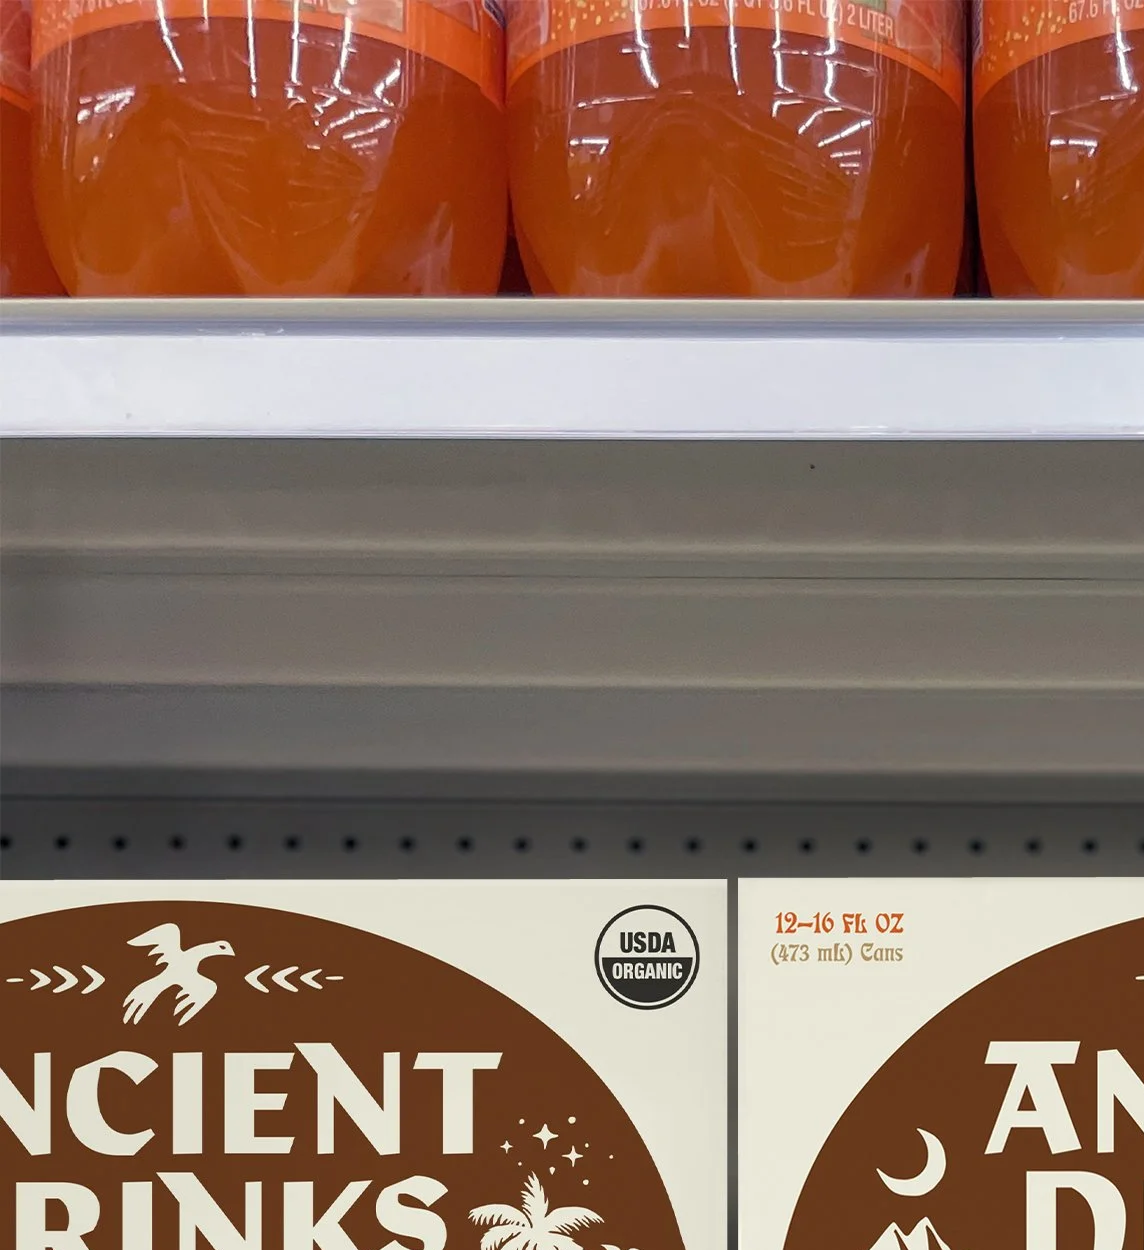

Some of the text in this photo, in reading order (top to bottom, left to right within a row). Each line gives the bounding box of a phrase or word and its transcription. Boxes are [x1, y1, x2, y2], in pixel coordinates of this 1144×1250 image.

[859, 7, 894, 39] LITER
[1069, 1, 1099, 23] 67.6
[776, 912, 904, 933] 12–16 FL OZ
[620, 931, 676, 953] USDA
[771, 943, 903, 965] (473 mL) Cans
[612, 962, 683, 980] ORGANIC
[0, 1042, 503, 1156] NCIENT
